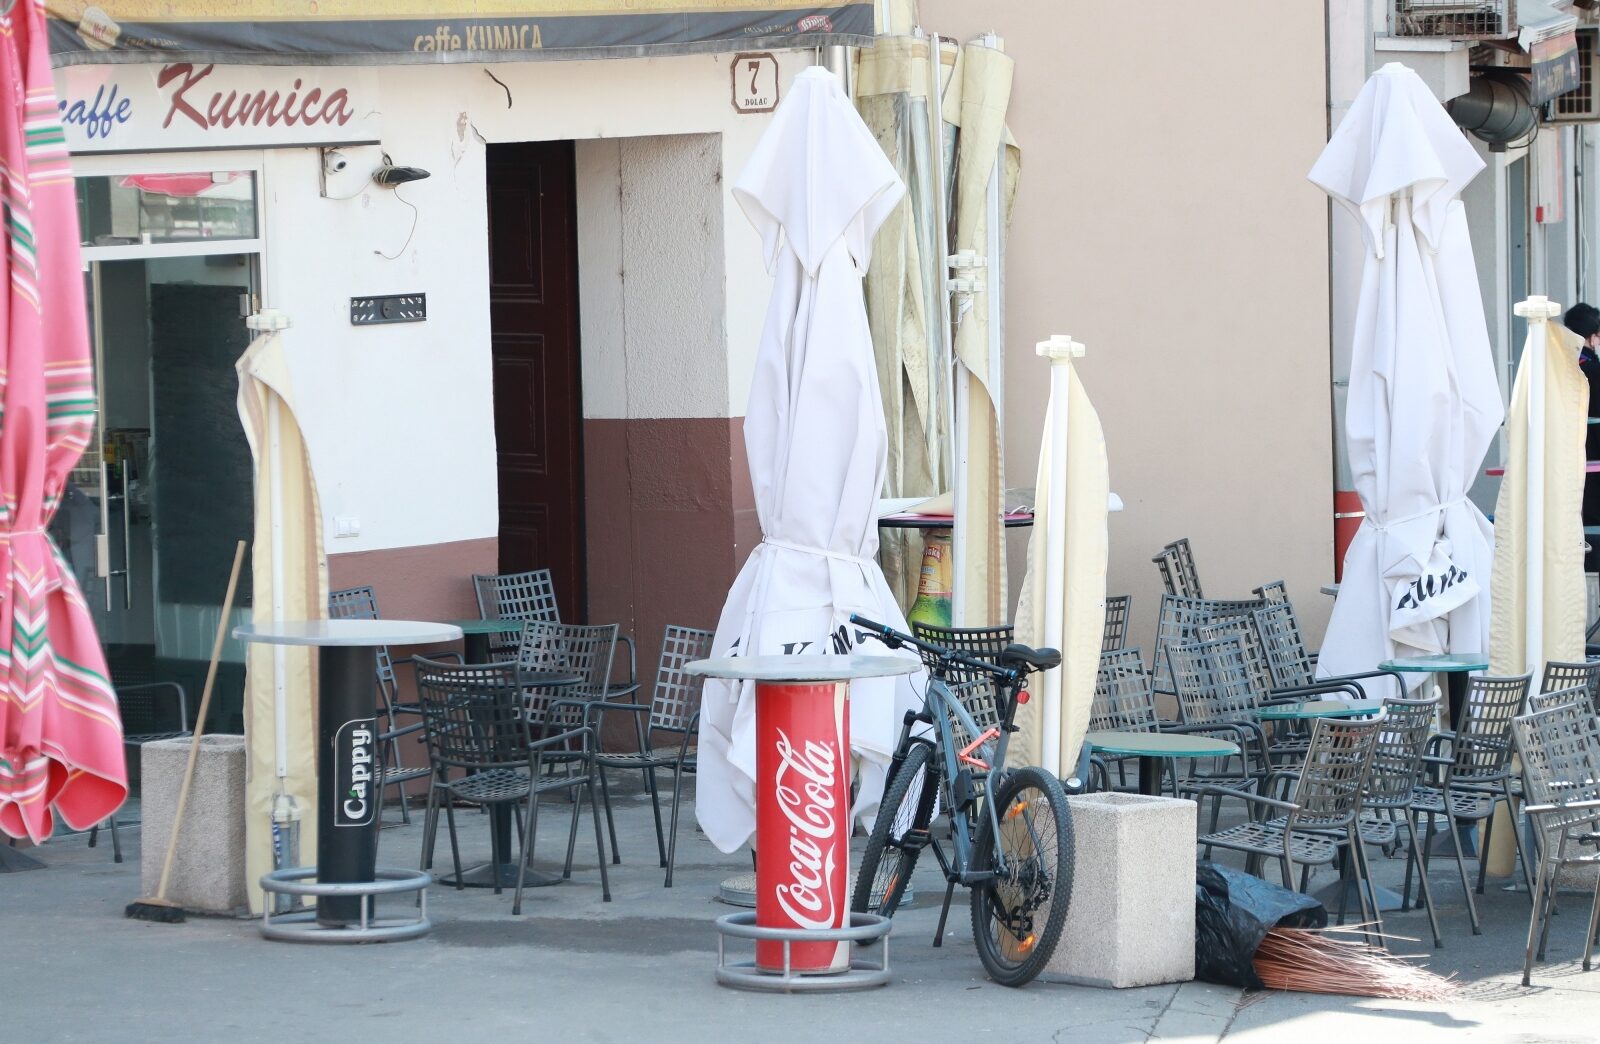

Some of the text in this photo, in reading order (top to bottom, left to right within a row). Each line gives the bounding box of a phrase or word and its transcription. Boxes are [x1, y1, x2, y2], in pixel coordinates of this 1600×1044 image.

[413, 26, 461, 52] caffe
[157, 63, 354, 131] Kumica
[748, 61, 760, 95] 7
[344, 729, 373, 820] Cappy
[776, 727, 836, 930] Coca-Cola
